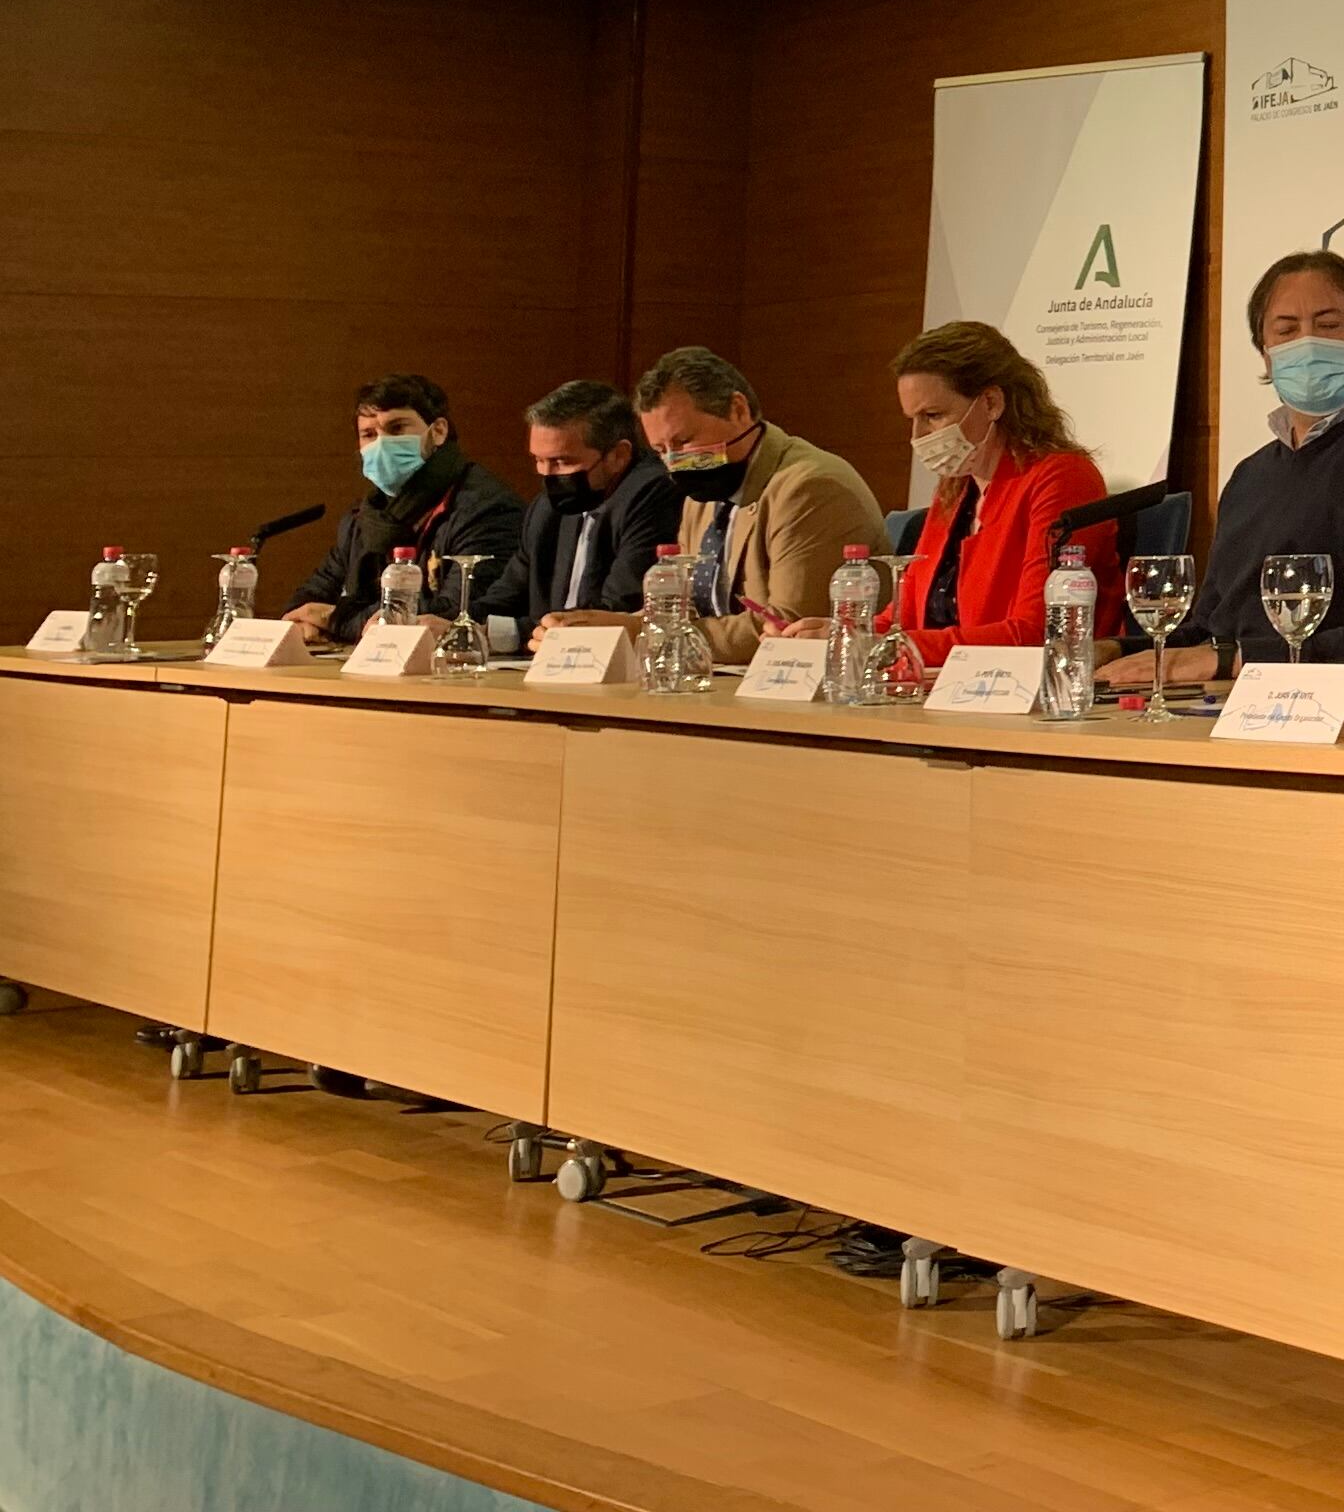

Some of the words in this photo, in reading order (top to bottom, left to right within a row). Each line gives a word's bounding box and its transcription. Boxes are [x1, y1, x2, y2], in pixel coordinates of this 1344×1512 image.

[1047, 299, 1076, 313] Junta
[1079, 296, 1093, 311] de
[1094, 291, 1153, 309] Andalucía
